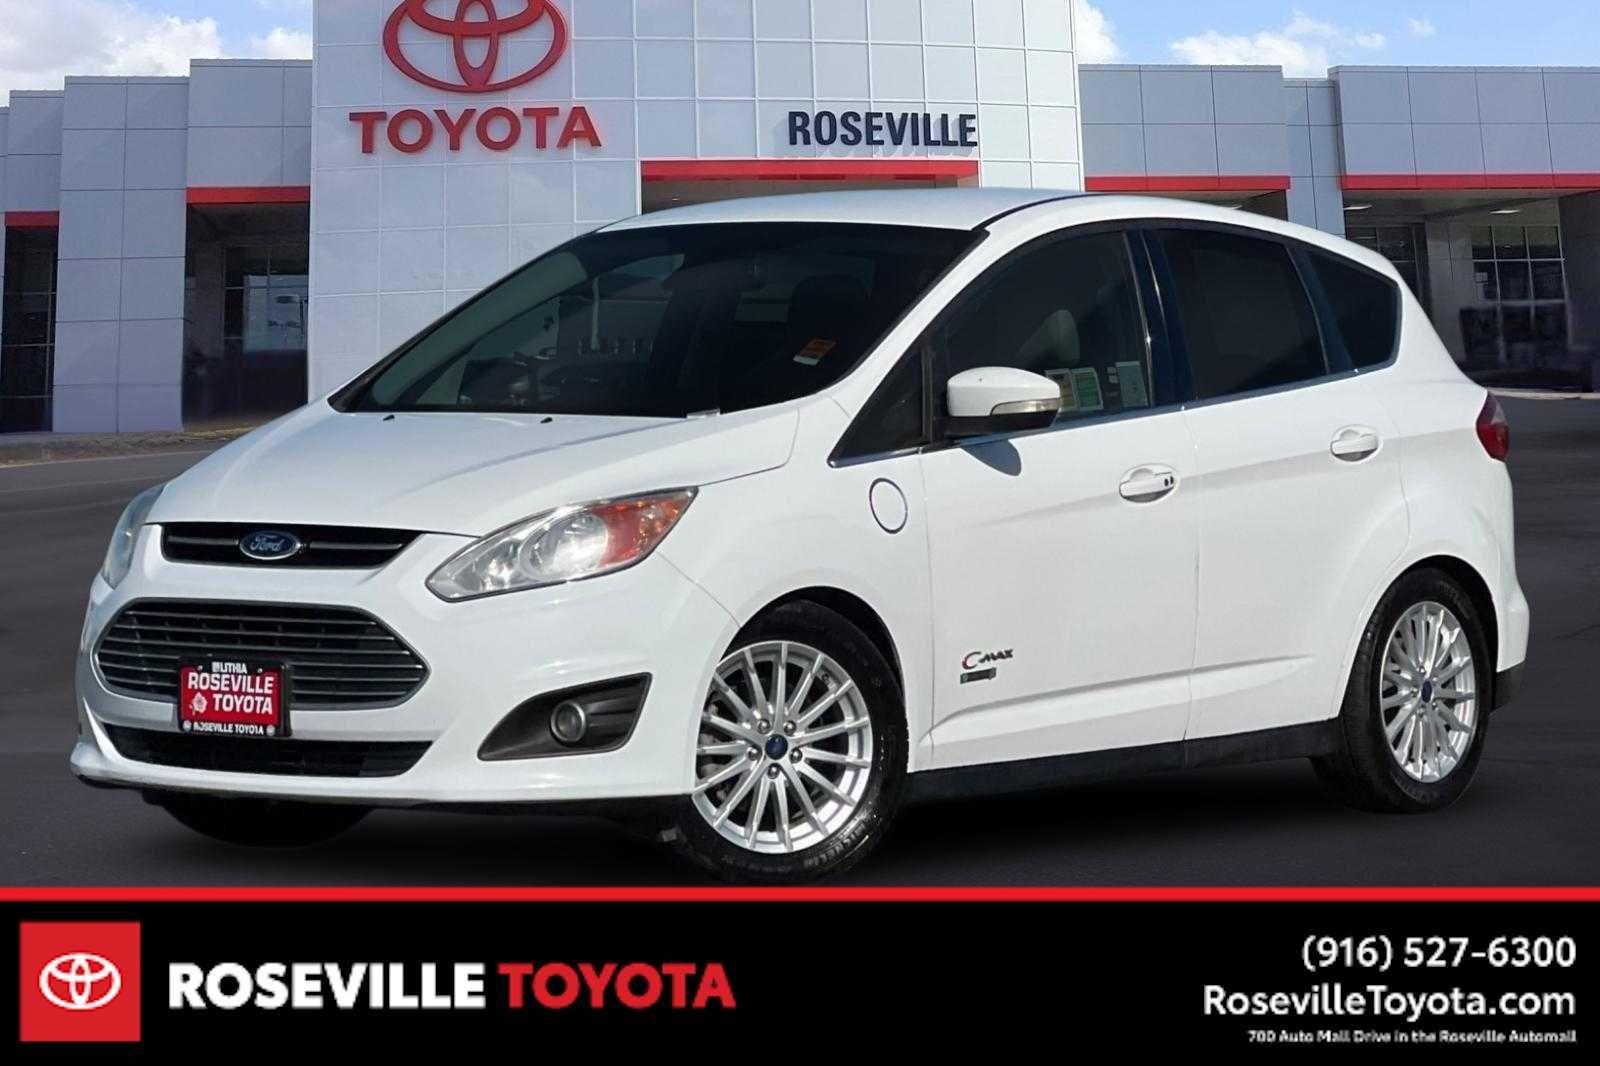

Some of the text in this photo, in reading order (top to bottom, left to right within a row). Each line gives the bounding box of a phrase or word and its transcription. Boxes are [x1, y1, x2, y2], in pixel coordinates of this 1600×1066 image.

[349, 106, 602, 154] TOYOTA
[788, 111, 978, 147] ROSEVILLE
[250, 535, 285, 551] Ford
[220, 662, 247, 674] LITHIA
[189, 673, 273, 693] ROSEVILLE
[213, 694, 272, 714] TOYOTA
[193, 722, 263, 734] ROSEVILLE TOYOTA
